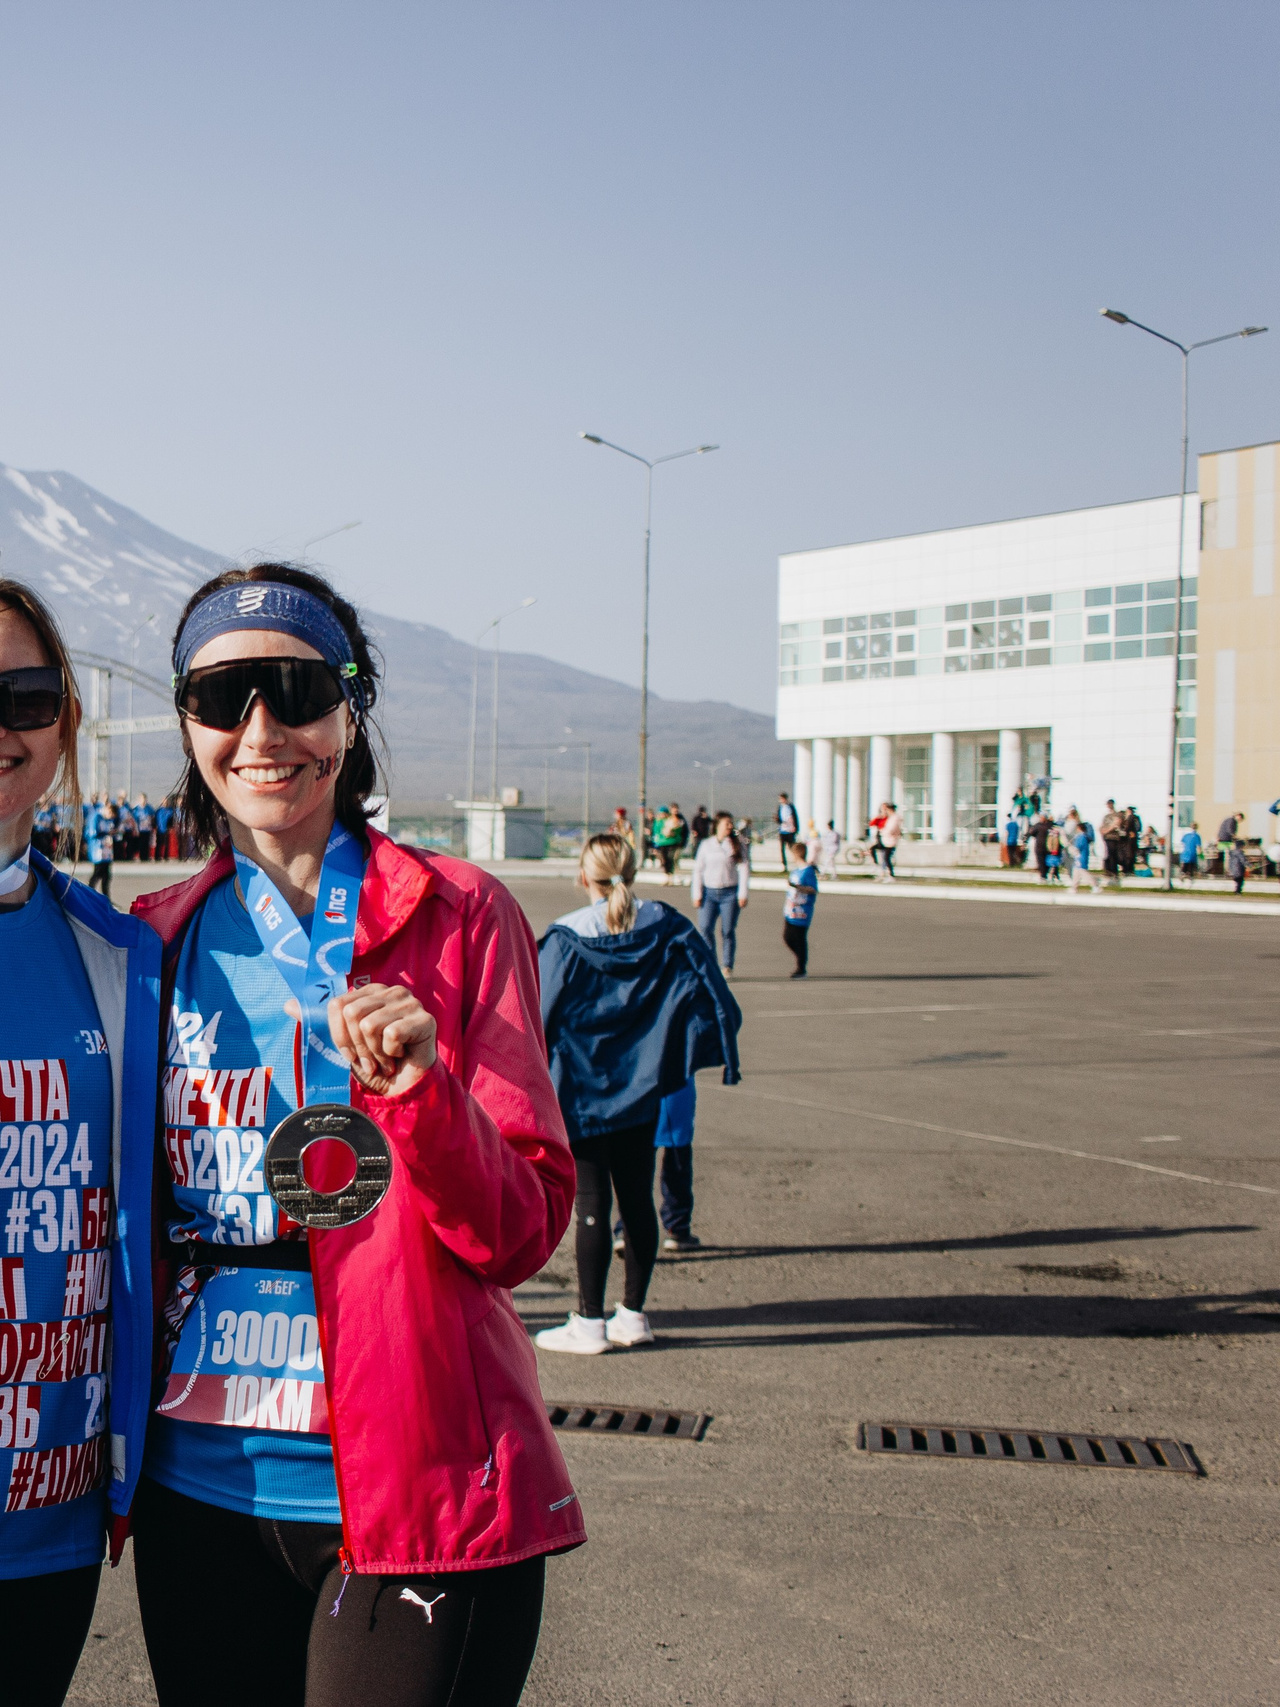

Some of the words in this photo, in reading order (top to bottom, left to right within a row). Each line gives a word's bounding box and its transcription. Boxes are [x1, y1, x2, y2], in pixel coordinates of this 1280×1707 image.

[262, 903, 283, 931] ПСБ
[329, 887, 348, 911] ПСБ
[211, 1309, 324, 1371] 3000
[223, 1374, 315, 1433] 10КМ
